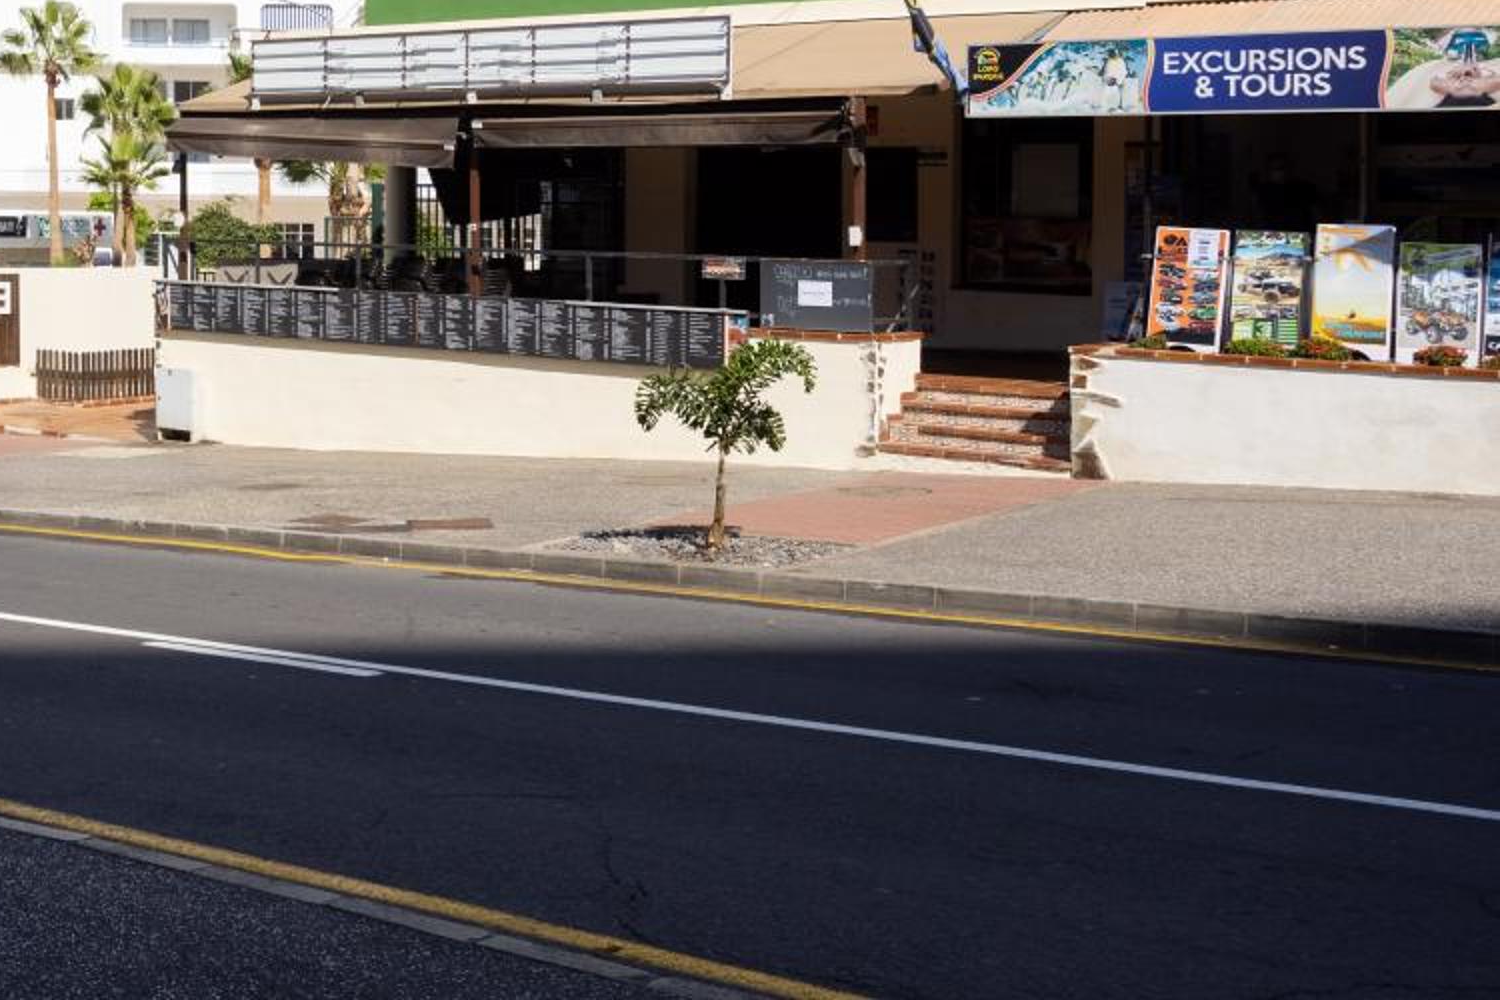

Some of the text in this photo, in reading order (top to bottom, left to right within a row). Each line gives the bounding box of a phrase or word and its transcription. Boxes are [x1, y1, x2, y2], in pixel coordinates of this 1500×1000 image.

[1163, 45, 1368, 75] EXCURSIONS
[1194, 72, 1332, 99] & TOURS
